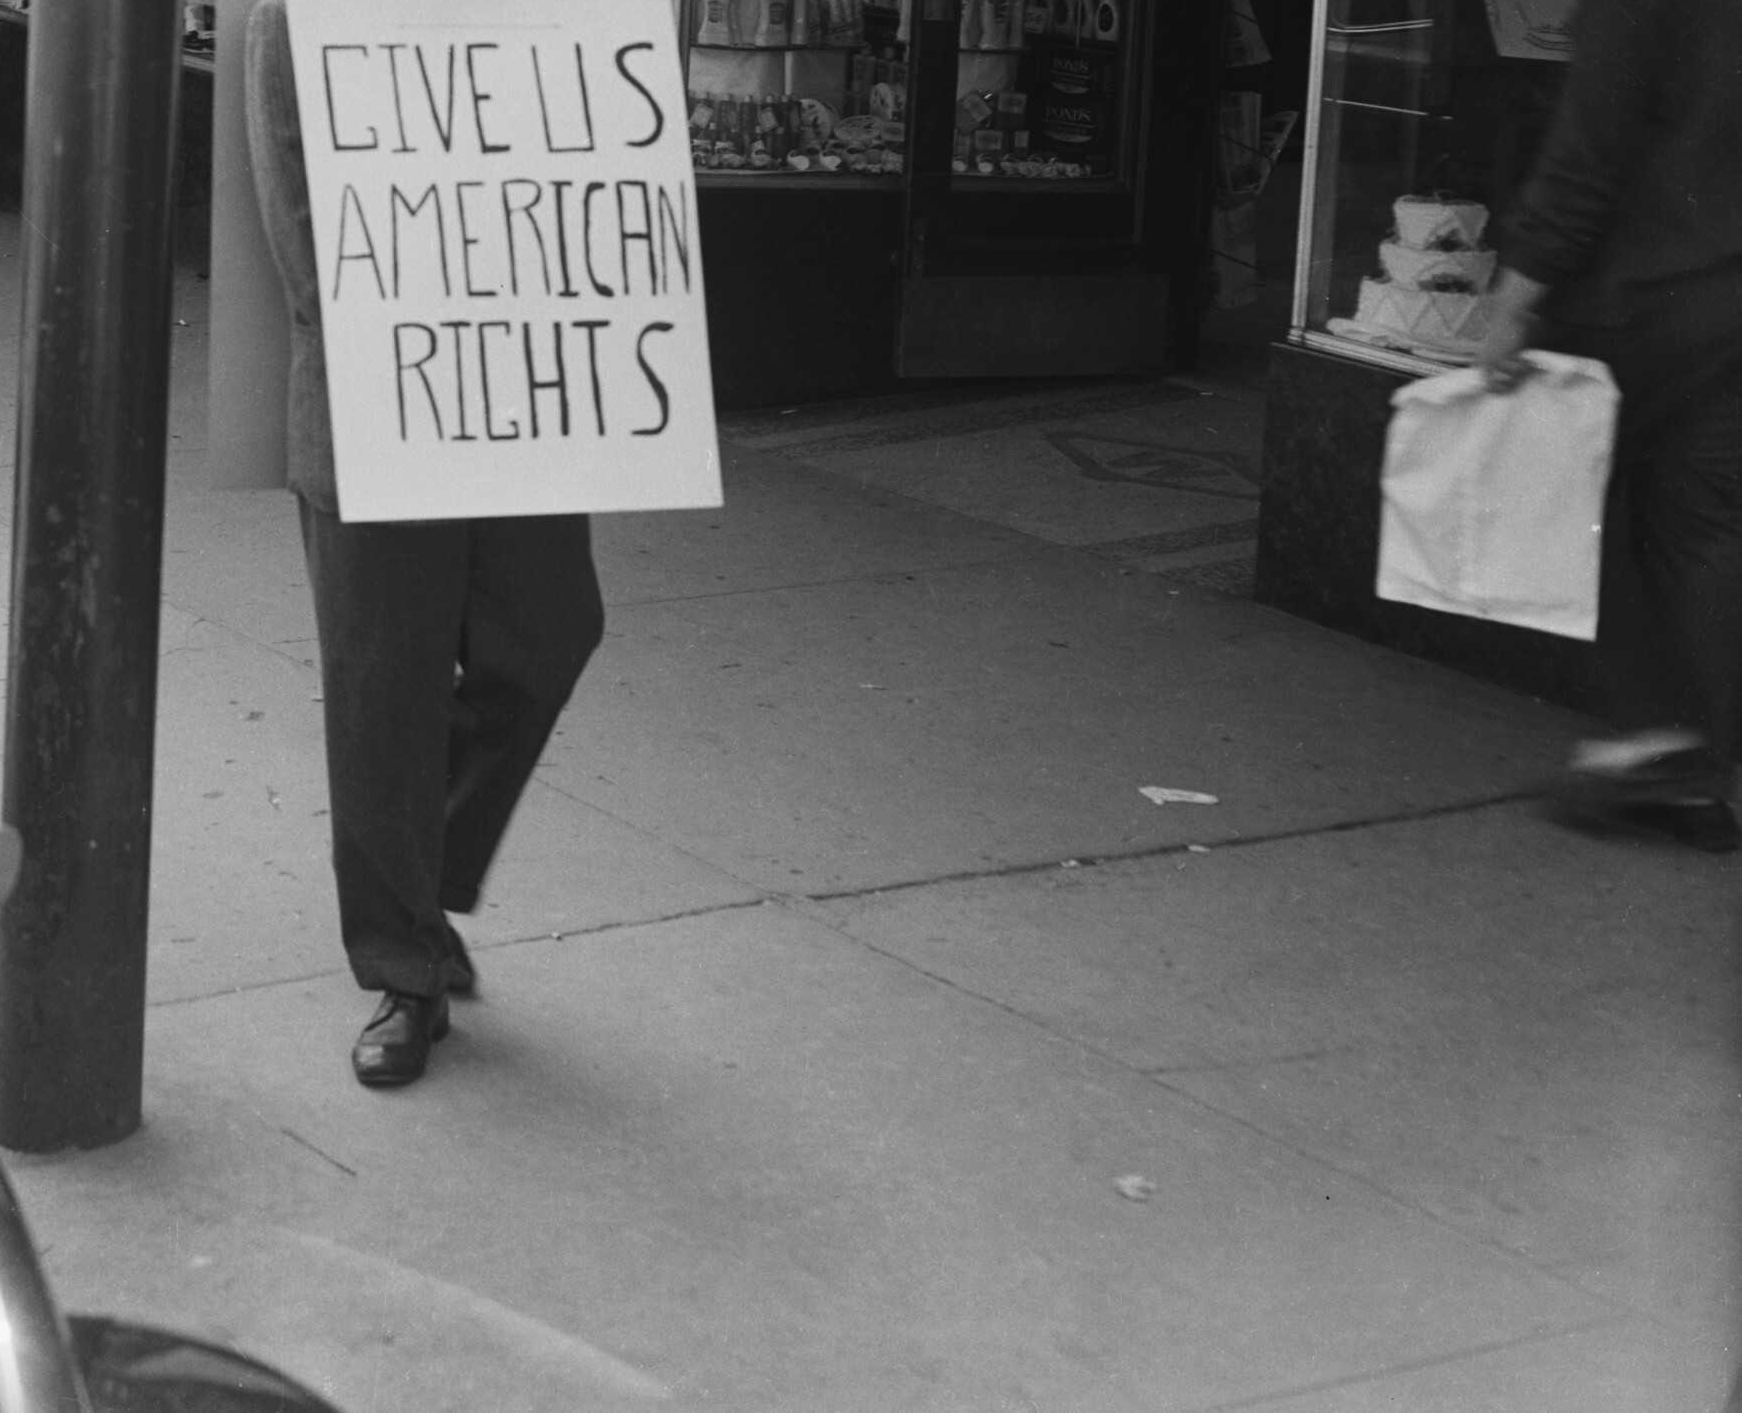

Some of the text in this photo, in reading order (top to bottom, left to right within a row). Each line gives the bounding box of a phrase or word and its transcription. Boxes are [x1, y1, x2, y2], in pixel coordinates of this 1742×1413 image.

[322, 41, 666, 154] GIVE US
[333, 179, 692, 301] AMERICAN
[393, 319, 675, 442] RIGHTS
